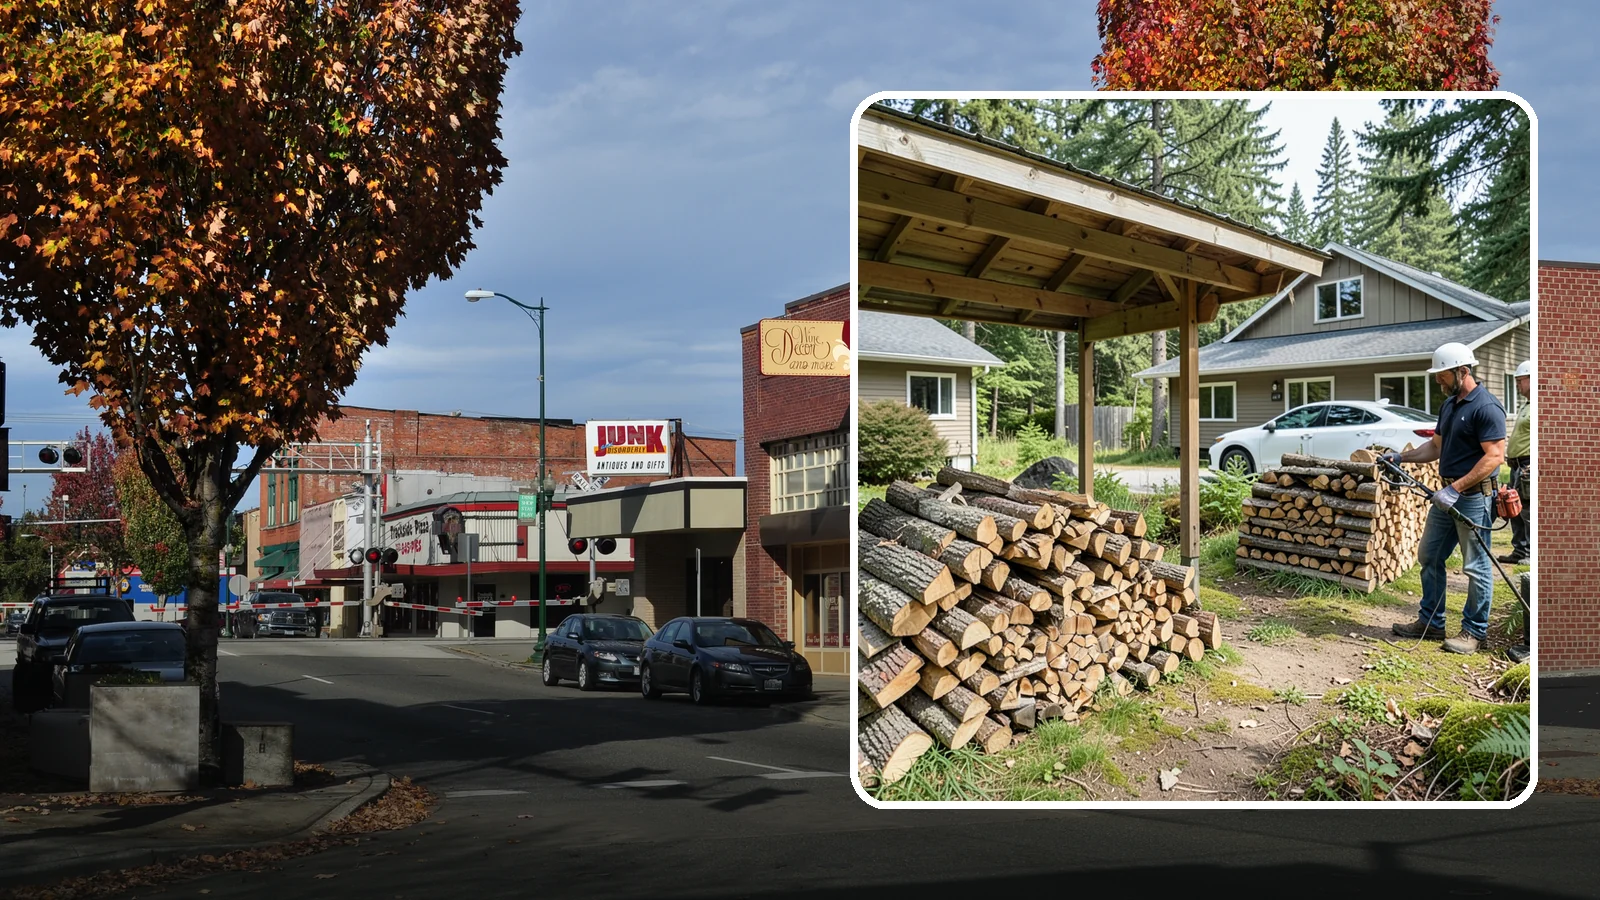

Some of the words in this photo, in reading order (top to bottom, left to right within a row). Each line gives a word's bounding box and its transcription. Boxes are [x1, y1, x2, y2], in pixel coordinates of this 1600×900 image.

[765, 328, 831, 365] Decor
[595, 425, 665, 457] JUNK
[608, 446, 646, 454] DISORDERLY
[597, 461, 628, 470] ANTIQUES
[631, 461, 644, 470] AND
[647, 460, 665, 470] GIFTS
[414, 520, 429, 535] Pizza
